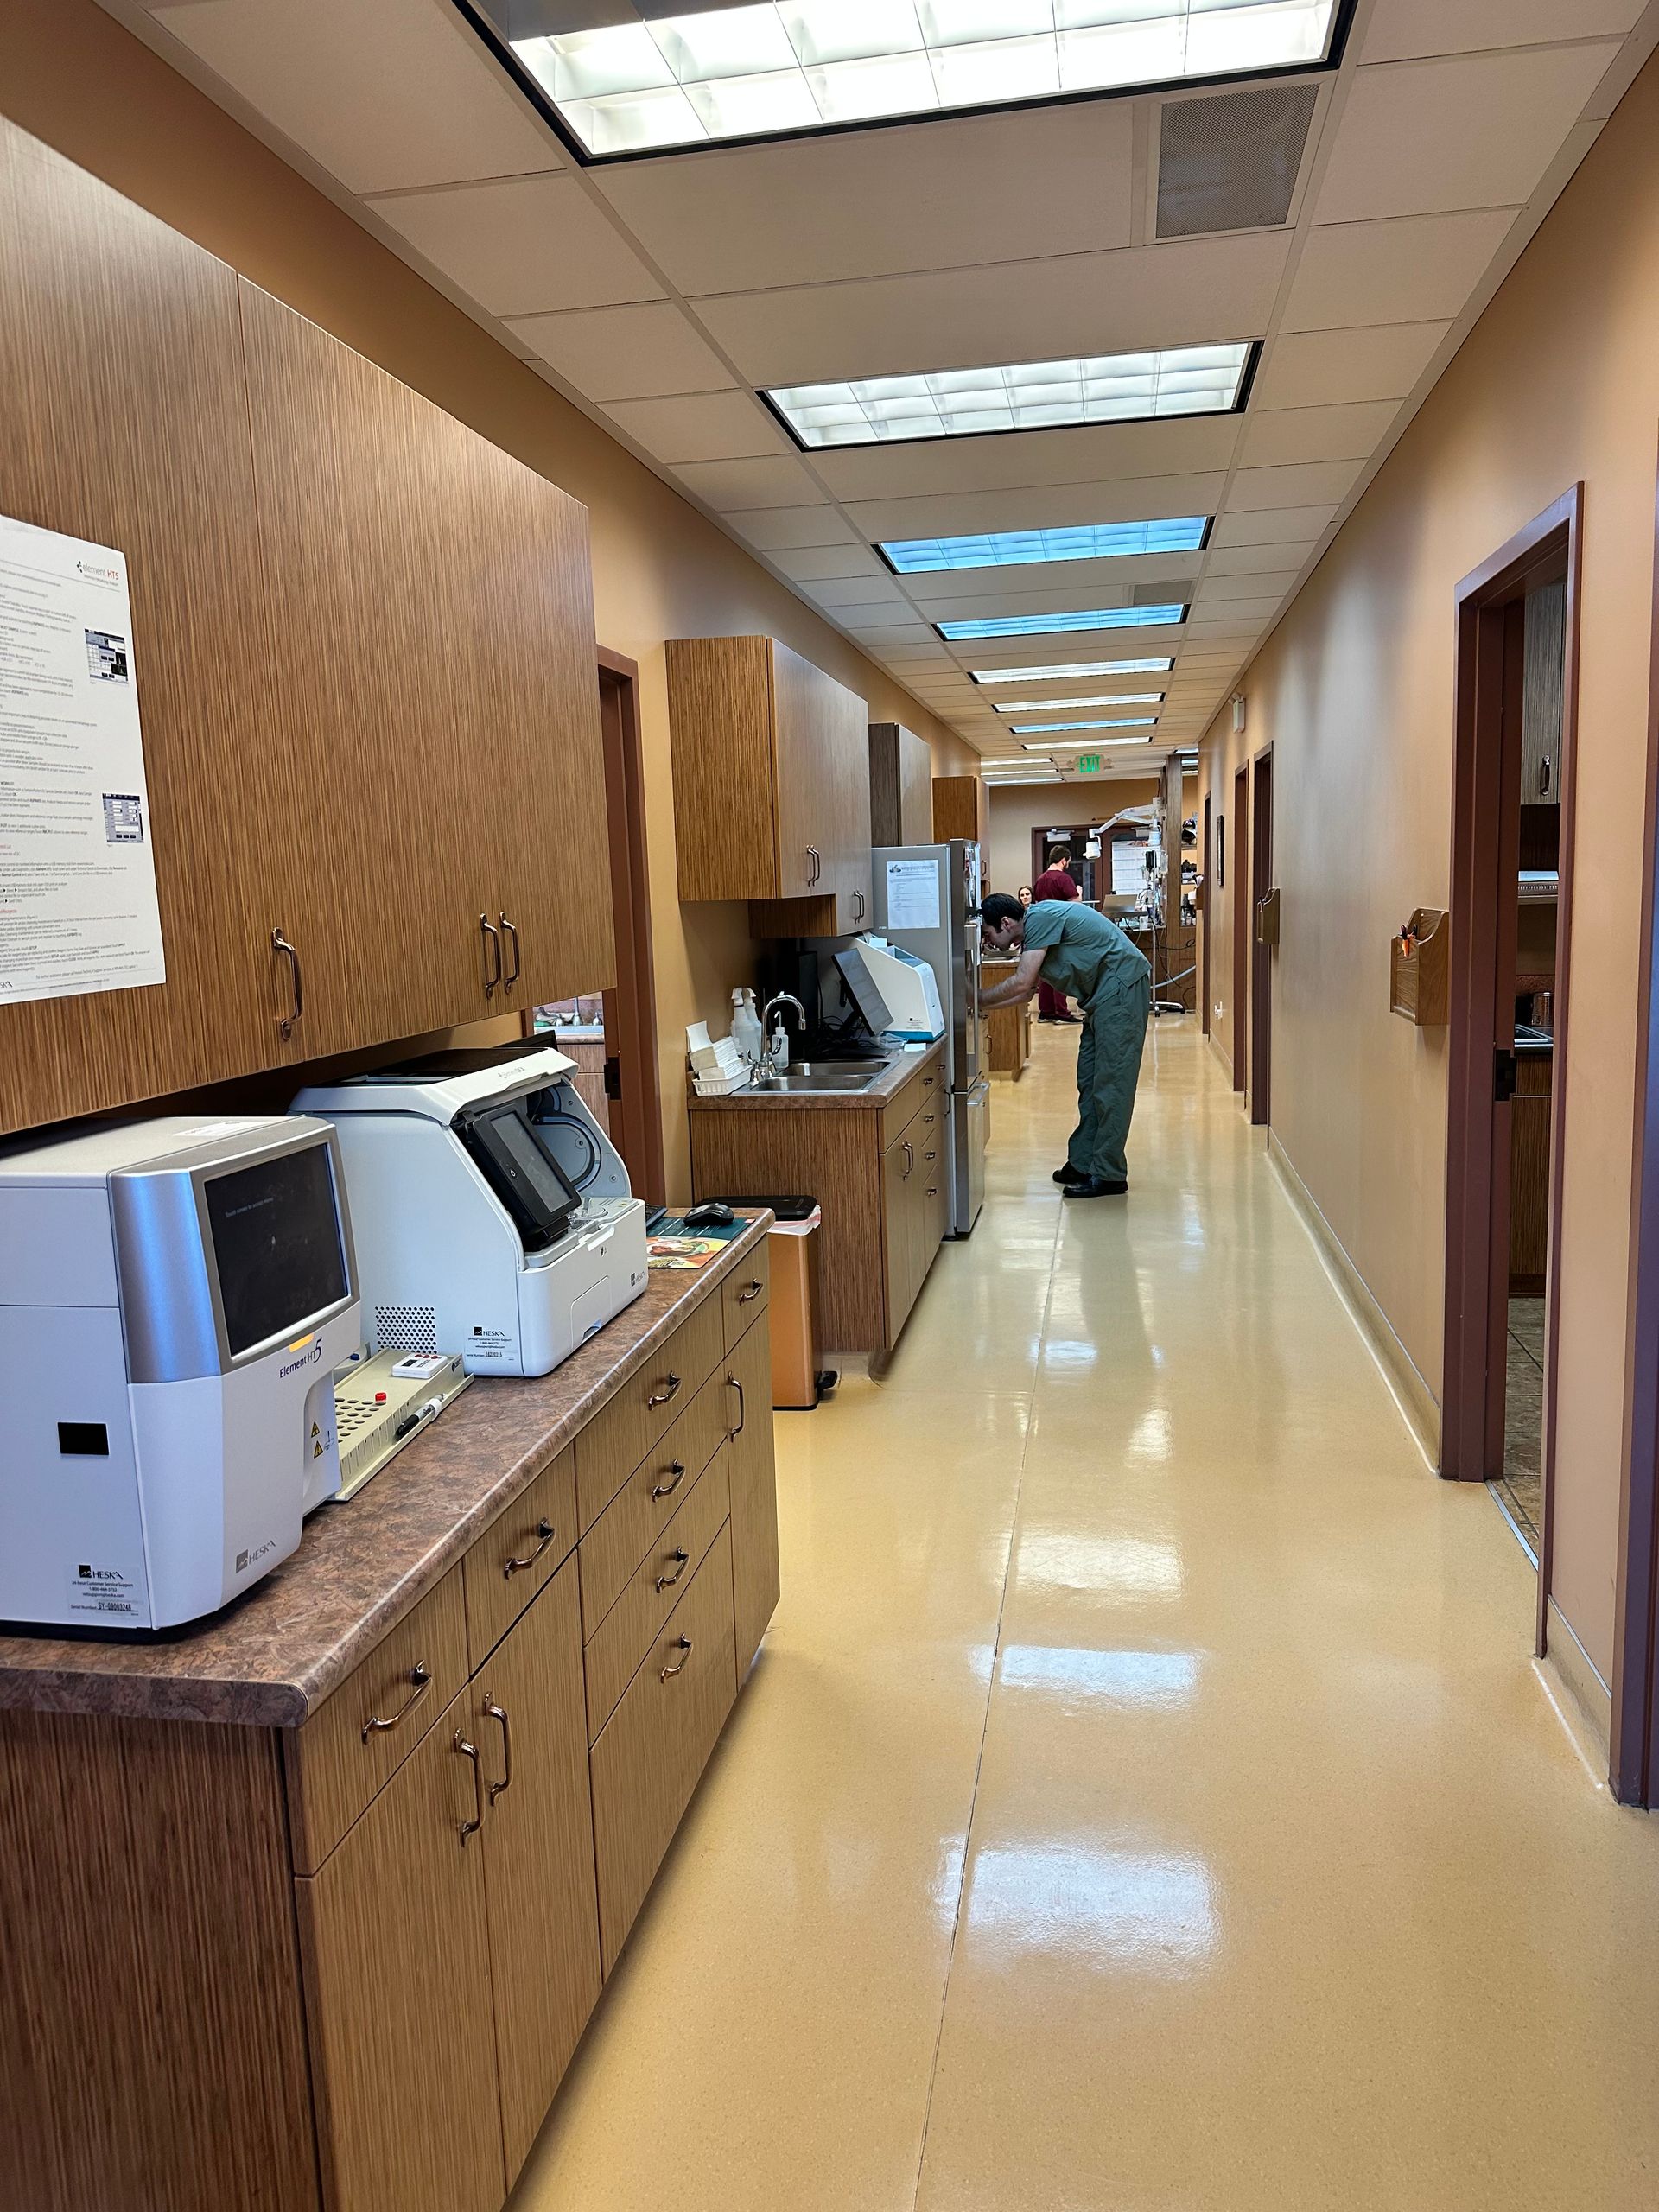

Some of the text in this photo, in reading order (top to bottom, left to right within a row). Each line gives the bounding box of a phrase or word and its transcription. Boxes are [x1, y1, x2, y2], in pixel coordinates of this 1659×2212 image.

[1079, 755, 1100, 772] EXIT
[279, 1337, 323, 1379] Element HT5
[248, 1540, 276, 1565] HESKA
[92, 1571, 124, 1580] HESKA
